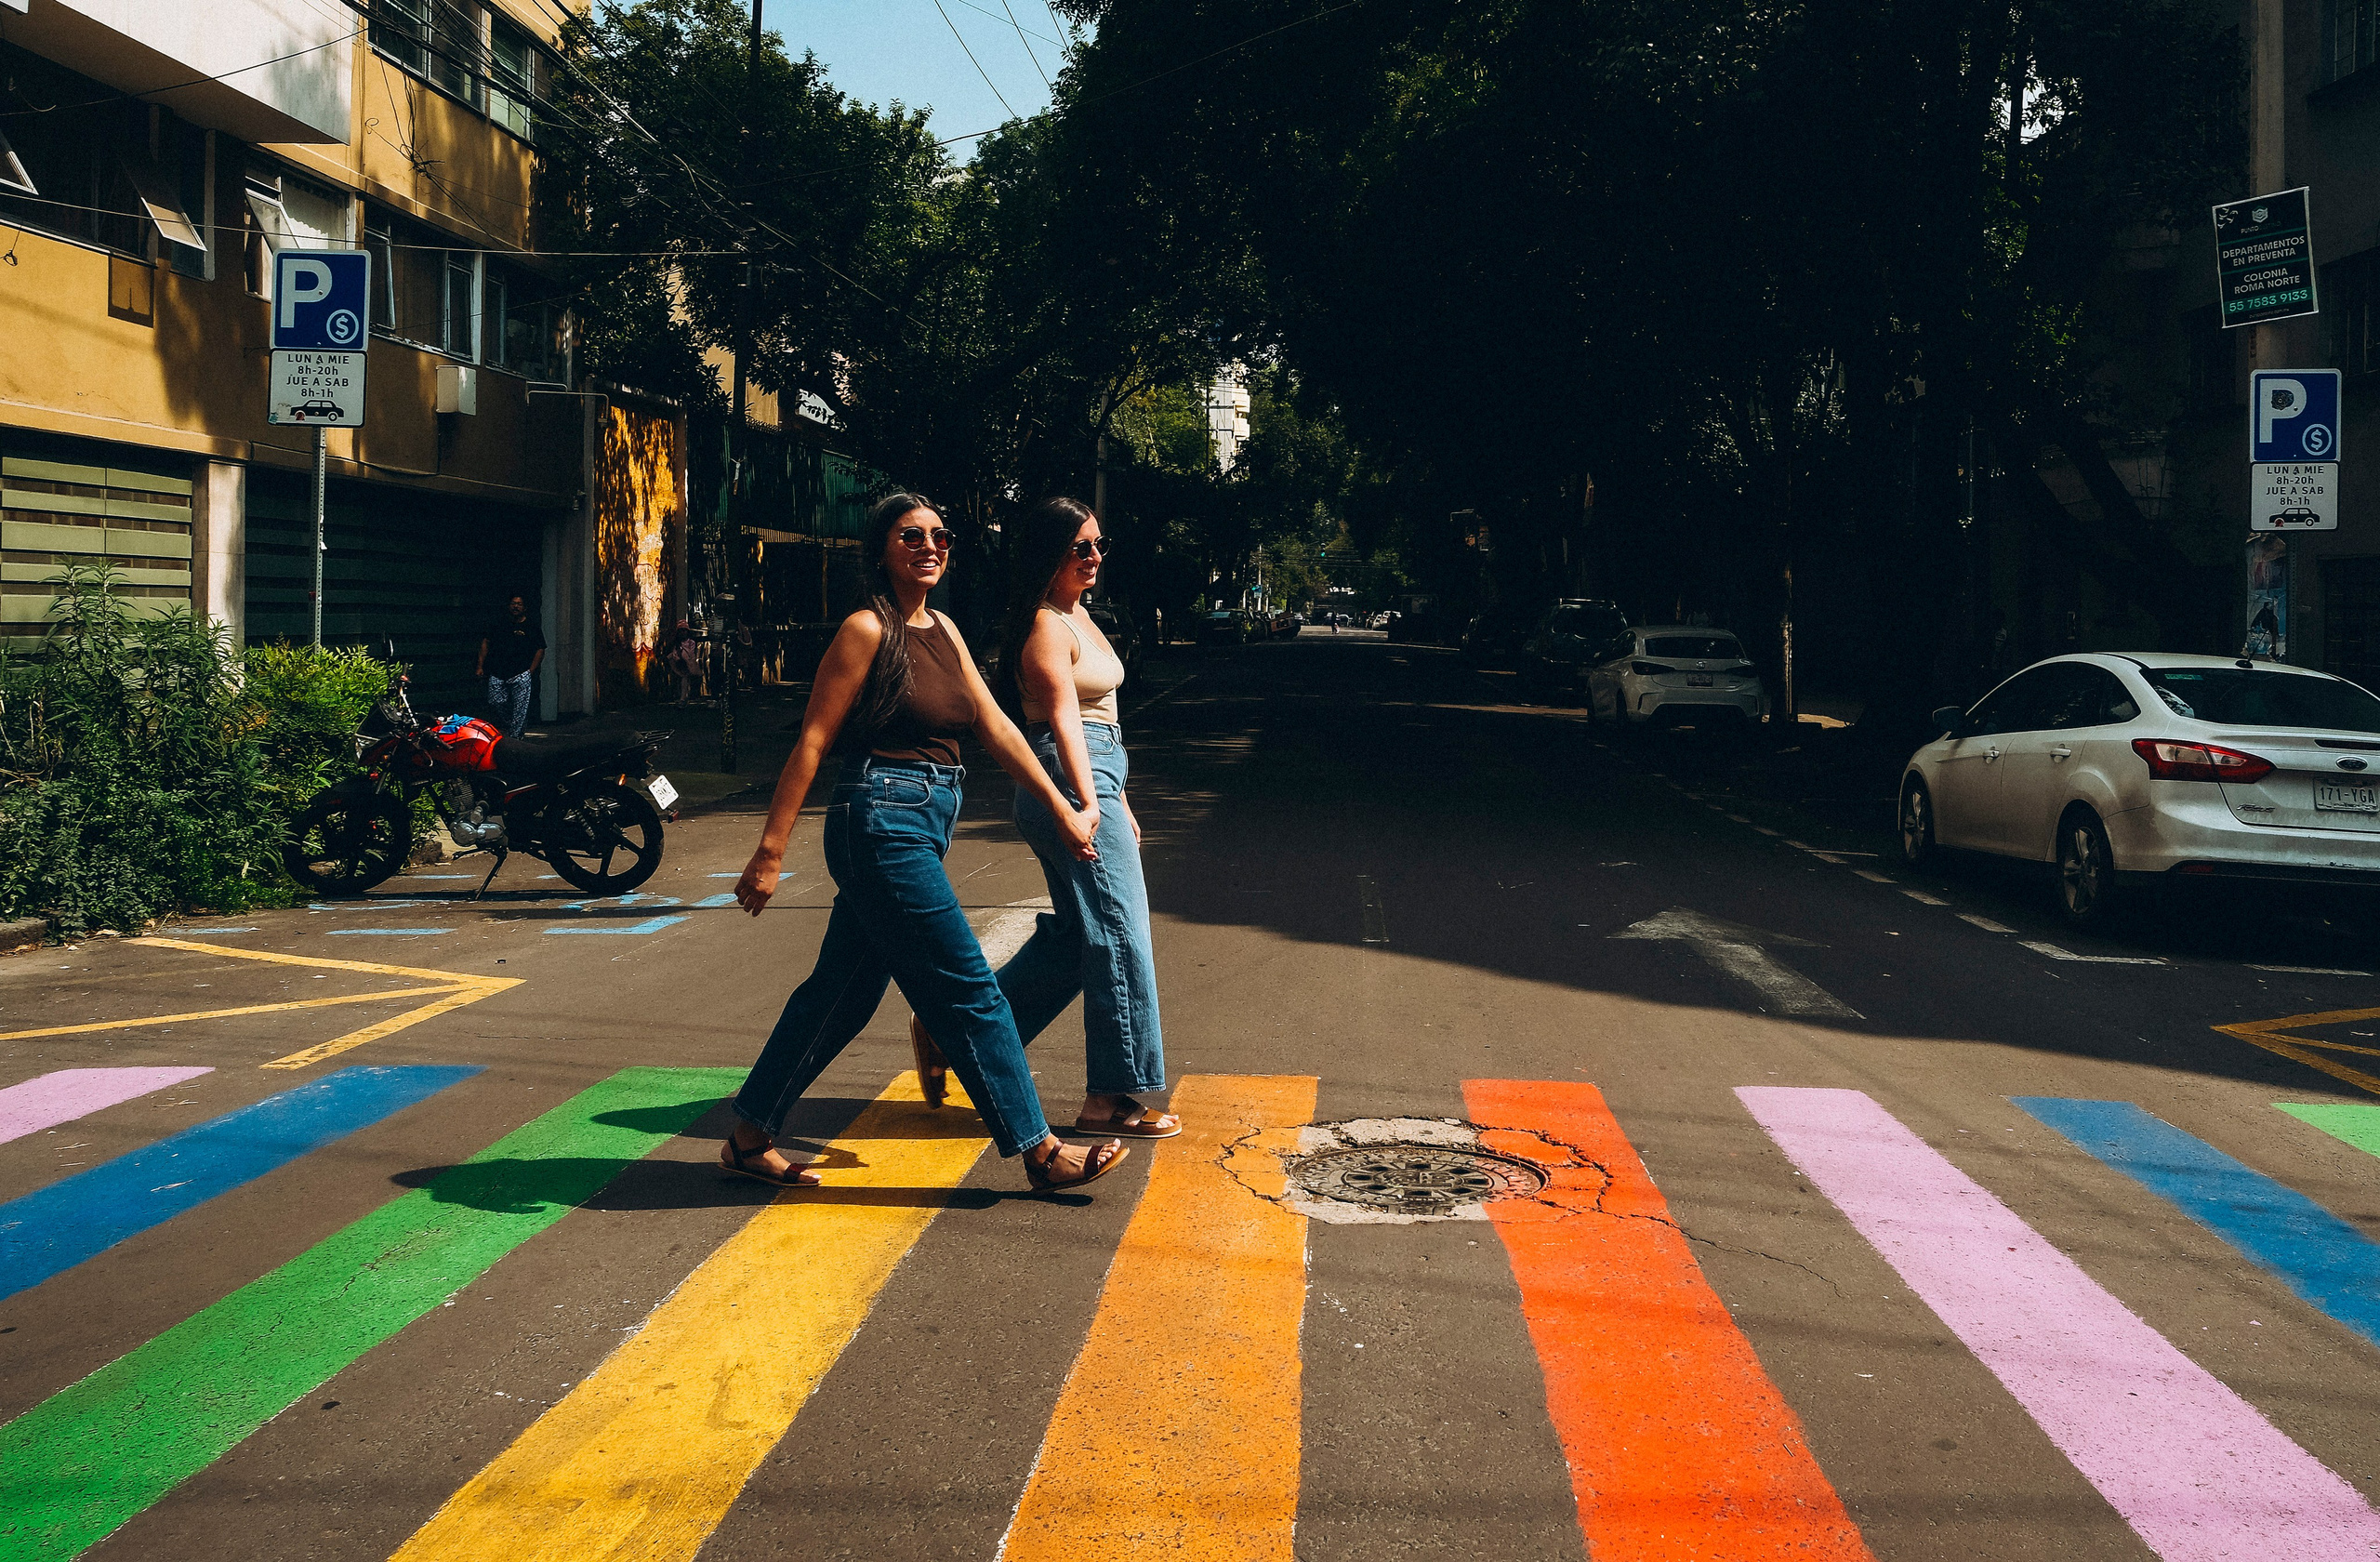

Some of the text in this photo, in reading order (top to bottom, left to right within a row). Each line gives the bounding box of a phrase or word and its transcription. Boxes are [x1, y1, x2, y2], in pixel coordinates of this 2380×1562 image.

[2222, 235, 2306, 259] DEPARTAMENTOS
[2232, 247, 2296, 267] EN PREVENTA
[2243, 268, 2288, 283] COLONIA
[2234, 275, 2301, 295] ROMA NORTE
[280, 258, 333, 328] P
[2229, 289, 2308, 312] 55 7583 9133
[287, 353, 350, 364] LUN A MIE
[298, 365, 338, 376] 8h-20h
[286, 376, 349, 387] JUE A SAB
[300, 388, 334, 398] 8h-1h
[2259, 378, 2307, 443] P
[2267, 466, 2324, 475] LUN A MIE
[2276, 476, 2314, 485] 8h-20h
[2266, 486, 2324, 496] JUE A SAB
[2280, 496, 2310, 506] 8h-1h
[2320, 787, 2375, 804] 171-YGA
